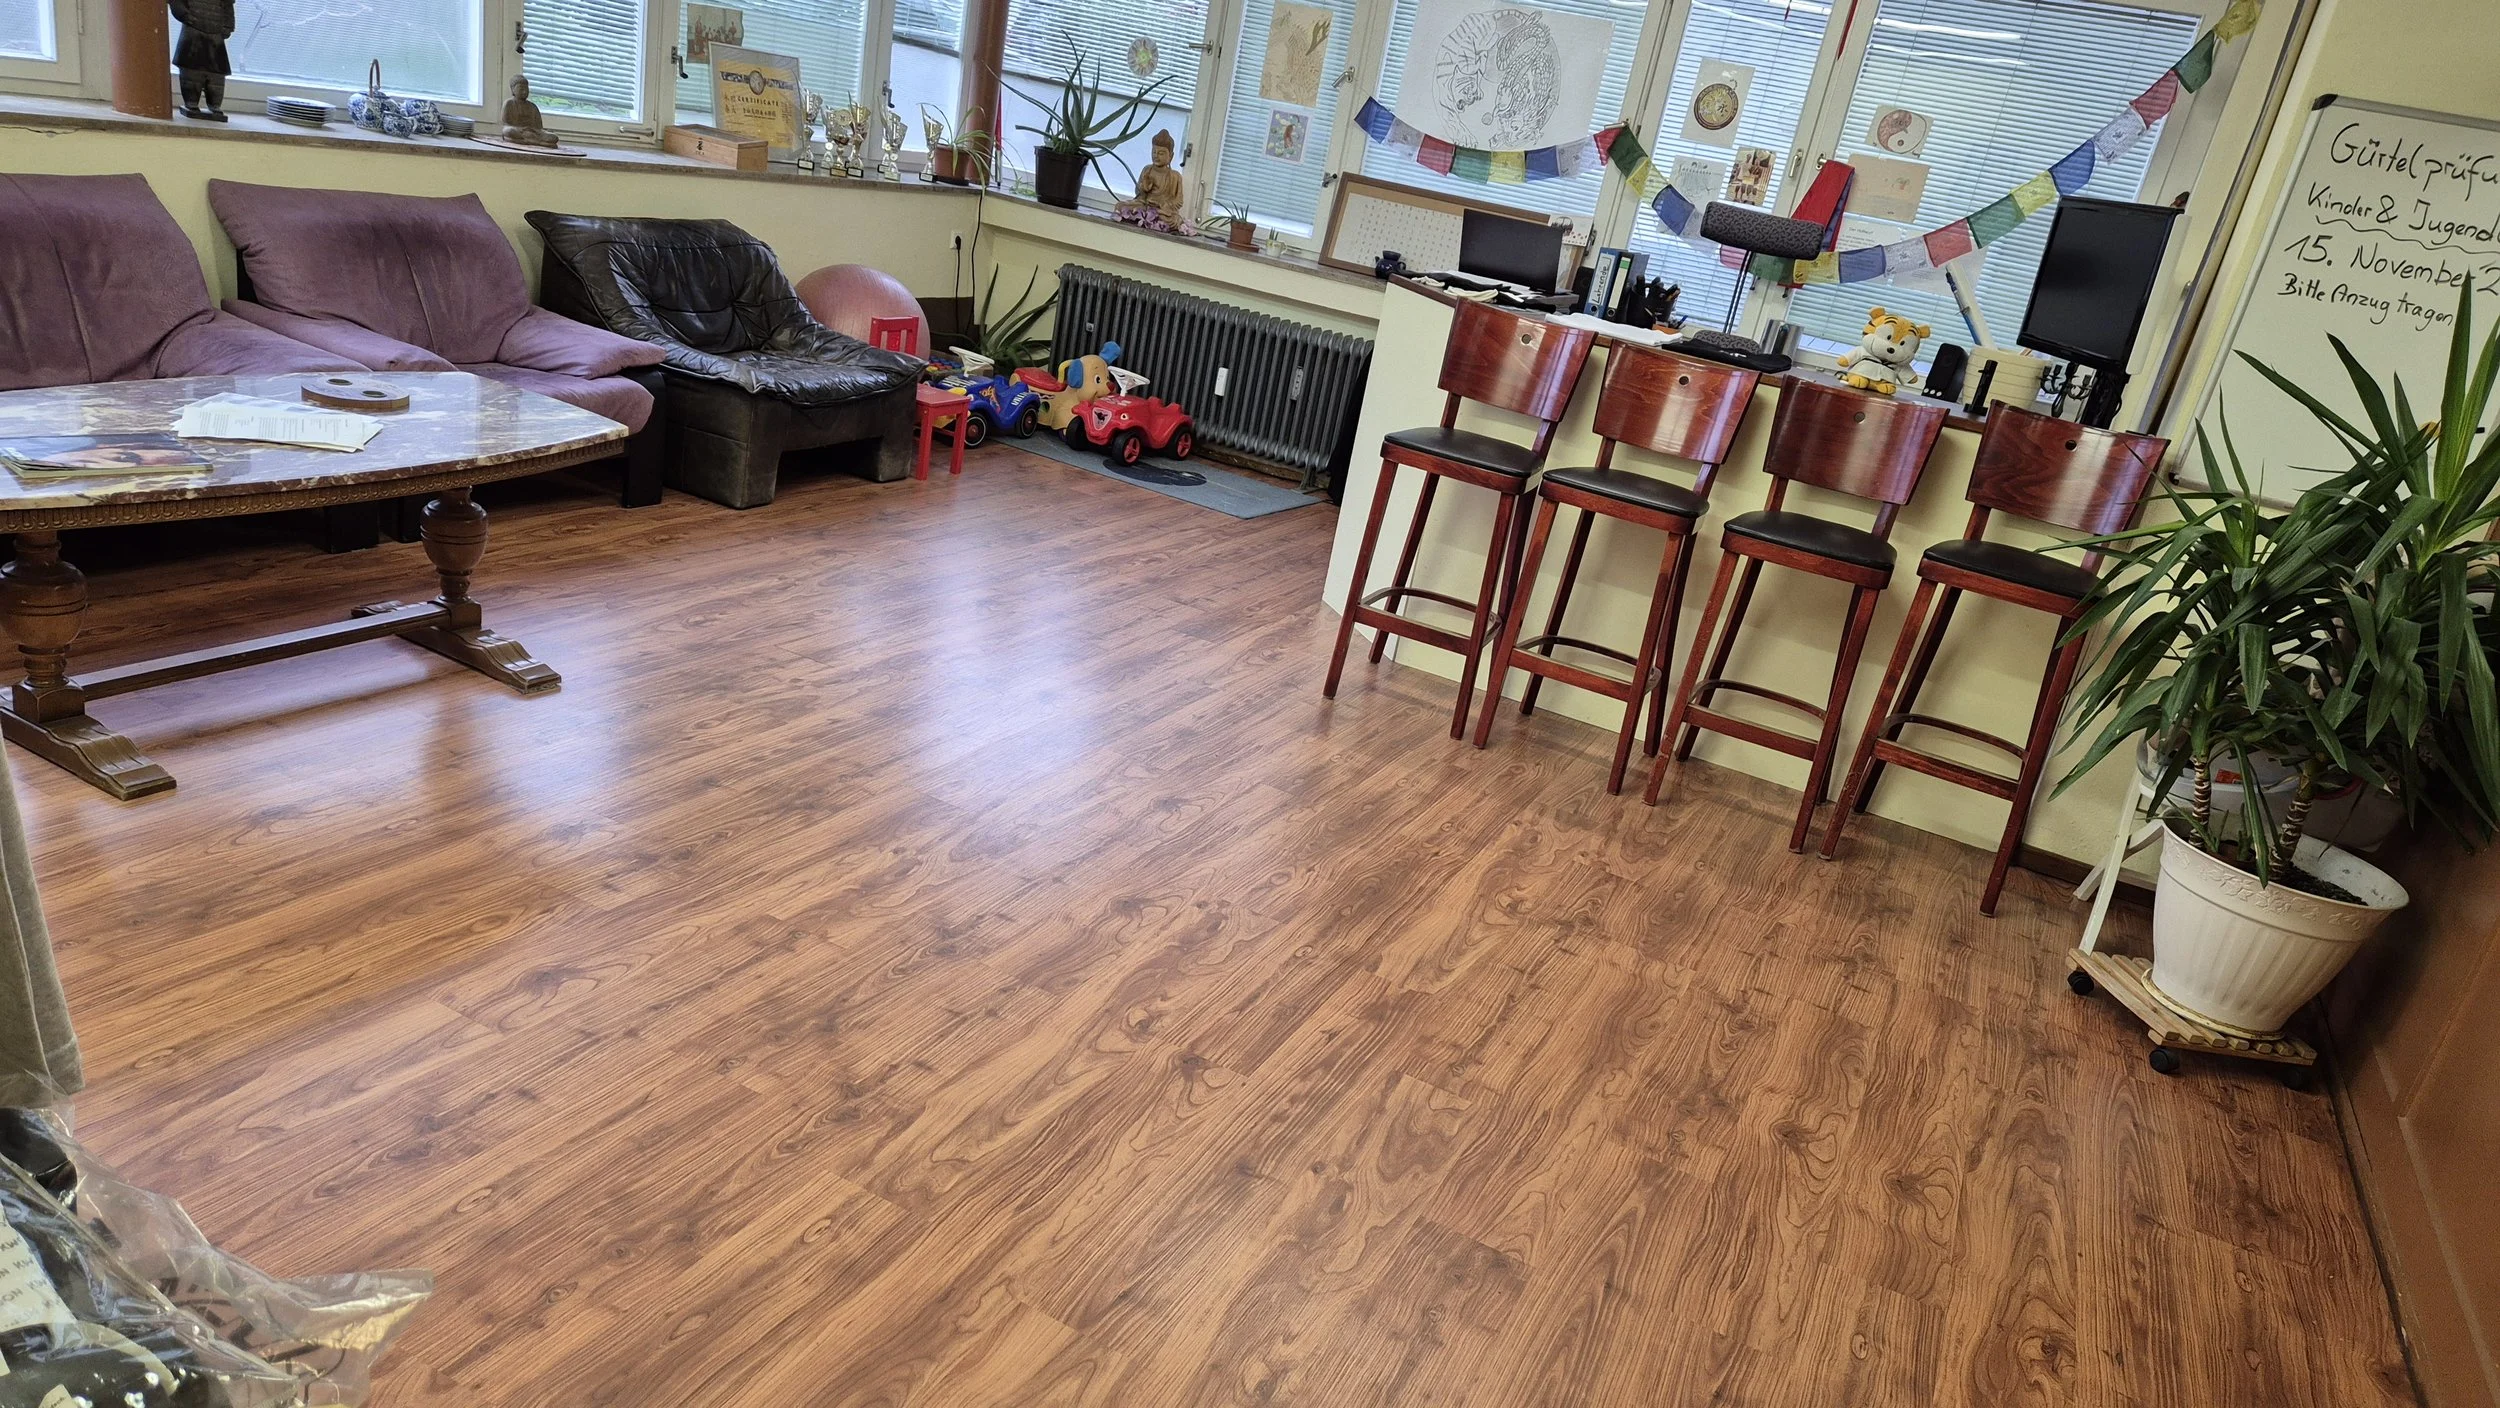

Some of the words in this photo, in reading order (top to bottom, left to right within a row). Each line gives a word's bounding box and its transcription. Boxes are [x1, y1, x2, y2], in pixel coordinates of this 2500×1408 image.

[2307, 182, 2373, 218] Kinder
[2375, 194, 2399, 224] &
[2408, 198, 2500, 246] Jugend
[2284, 234, 2334, 267] 15.
[2277, 272, 2326, 302] Bitte
[2330, 282, 2391, 325] Anzug
[2396, 292, 2455, 332] tragen
